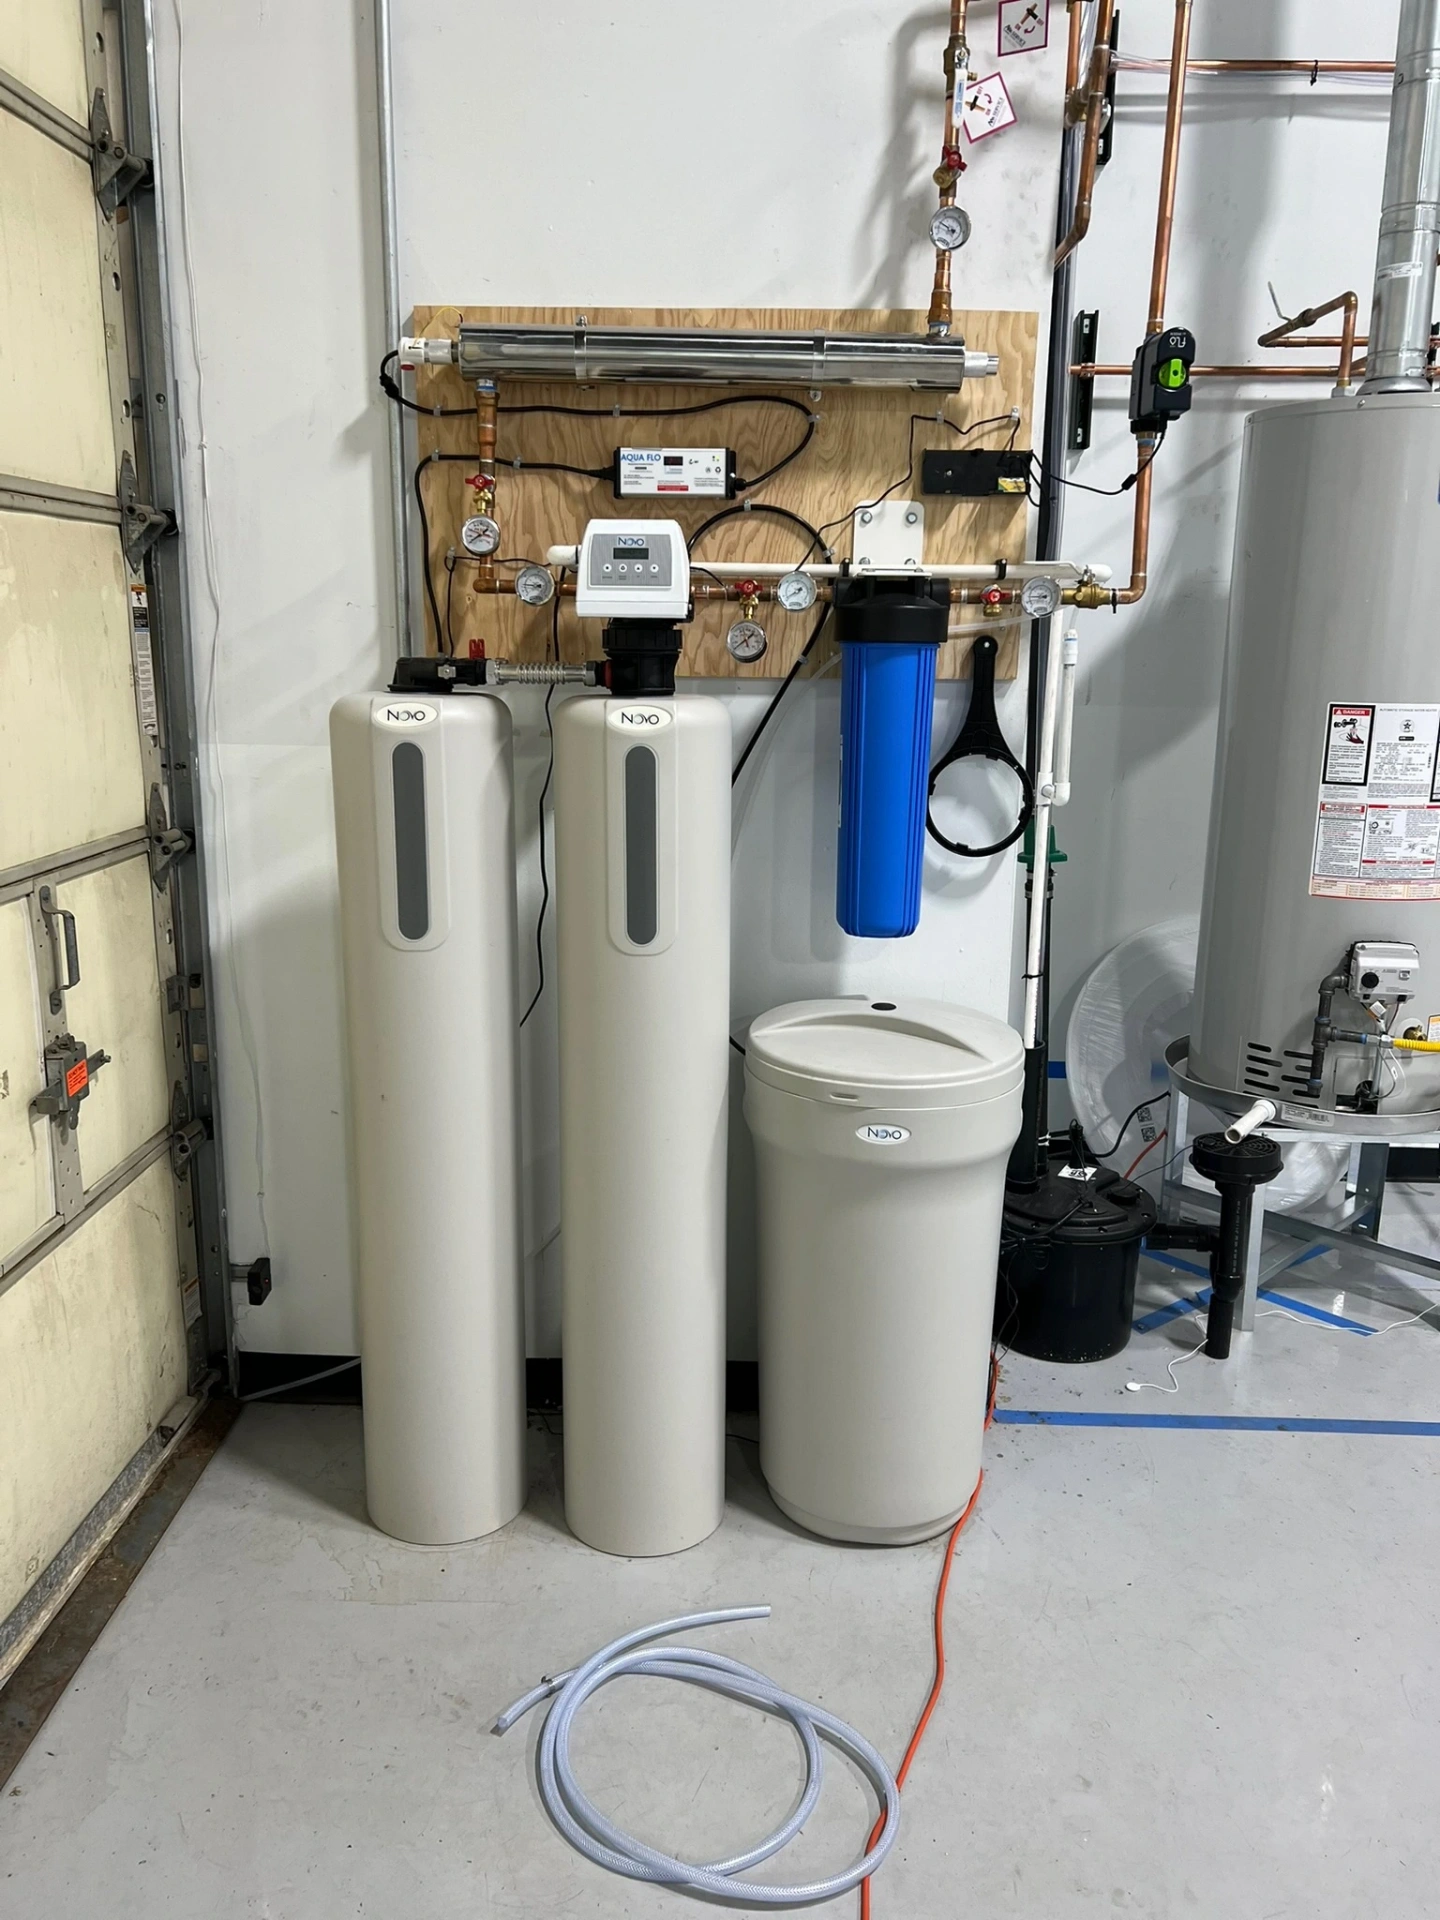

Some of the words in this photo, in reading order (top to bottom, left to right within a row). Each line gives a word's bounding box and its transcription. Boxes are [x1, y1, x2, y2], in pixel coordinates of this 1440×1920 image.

[621, 453, 645, 462] AQUA
[646, 453, 661, 462] FLO
[617, 537, 645, 547] NOVO
[386, 709, 426, 722] NOVO
[621, 711, 660, 725] NOVO
[867, 1126, 902, 1140] NOVO
